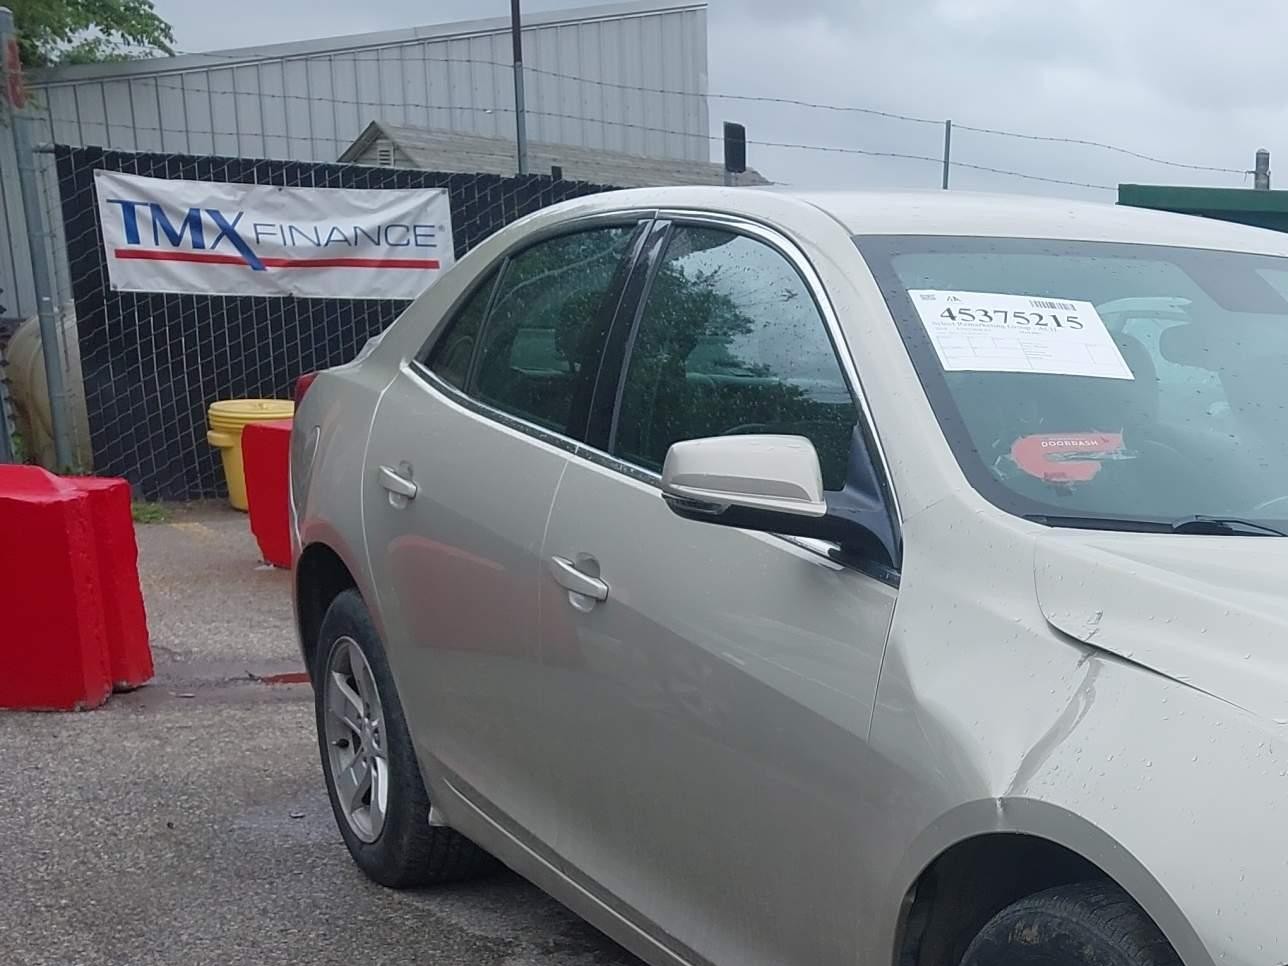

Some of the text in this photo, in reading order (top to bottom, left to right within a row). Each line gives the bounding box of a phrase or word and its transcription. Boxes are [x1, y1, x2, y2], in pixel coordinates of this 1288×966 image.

[107, 199, 437, 271] TMX FINANCE
[940, 306, 1084, 330] 45375215
[1041, 439, 1099, 449] DOORDASH
